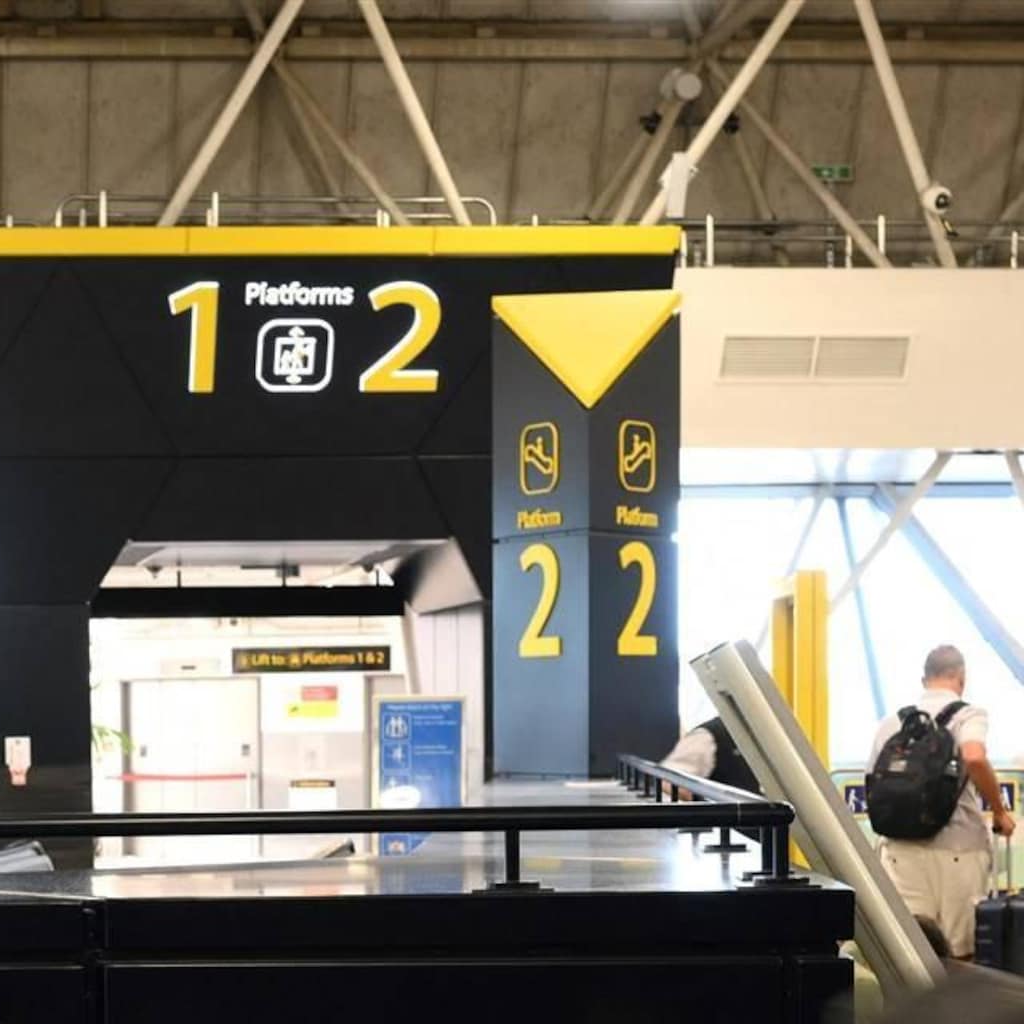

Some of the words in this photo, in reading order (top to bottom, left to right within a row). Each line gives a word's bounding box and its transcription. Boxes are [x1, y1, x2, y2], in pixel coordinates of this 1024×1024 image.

[168, 281, 220, 393] 1
[244, 281, 355, 306] Platforms
[358, 281, 442, 393] 2
[517, 509, 562, 529] Platform
[616, 506, 658, 528] Platform
[519, 544, 561, 658] 2
[616, 540, 658, 656] 2
[252, 653, 270, 666] Lift
[303, 651, 356, 665] Platforms
[365, 651, 375, 664] &
[376, 651, 385, 664] 2
